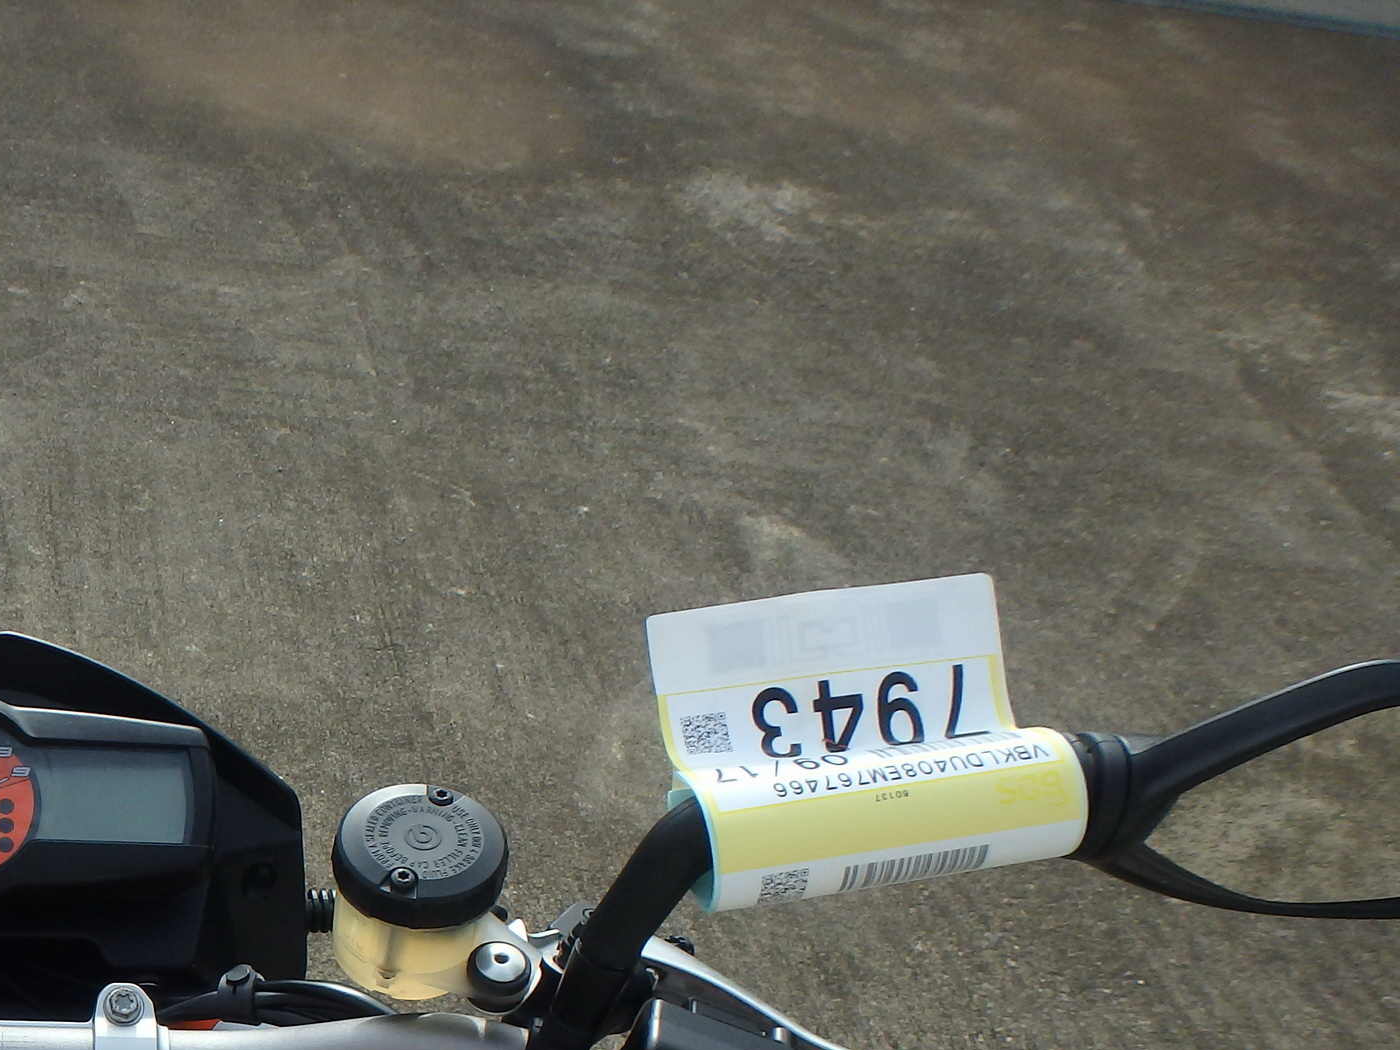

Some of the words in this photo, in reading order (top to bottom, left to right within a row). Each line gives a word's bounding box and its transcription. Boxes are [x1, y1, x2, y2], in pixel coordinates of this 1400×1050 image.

[752, 665, 989, 758] 7943
[11, 766, 30, 777] 9
[772, 742, 1049, 797] VBKLDU408EM767466
